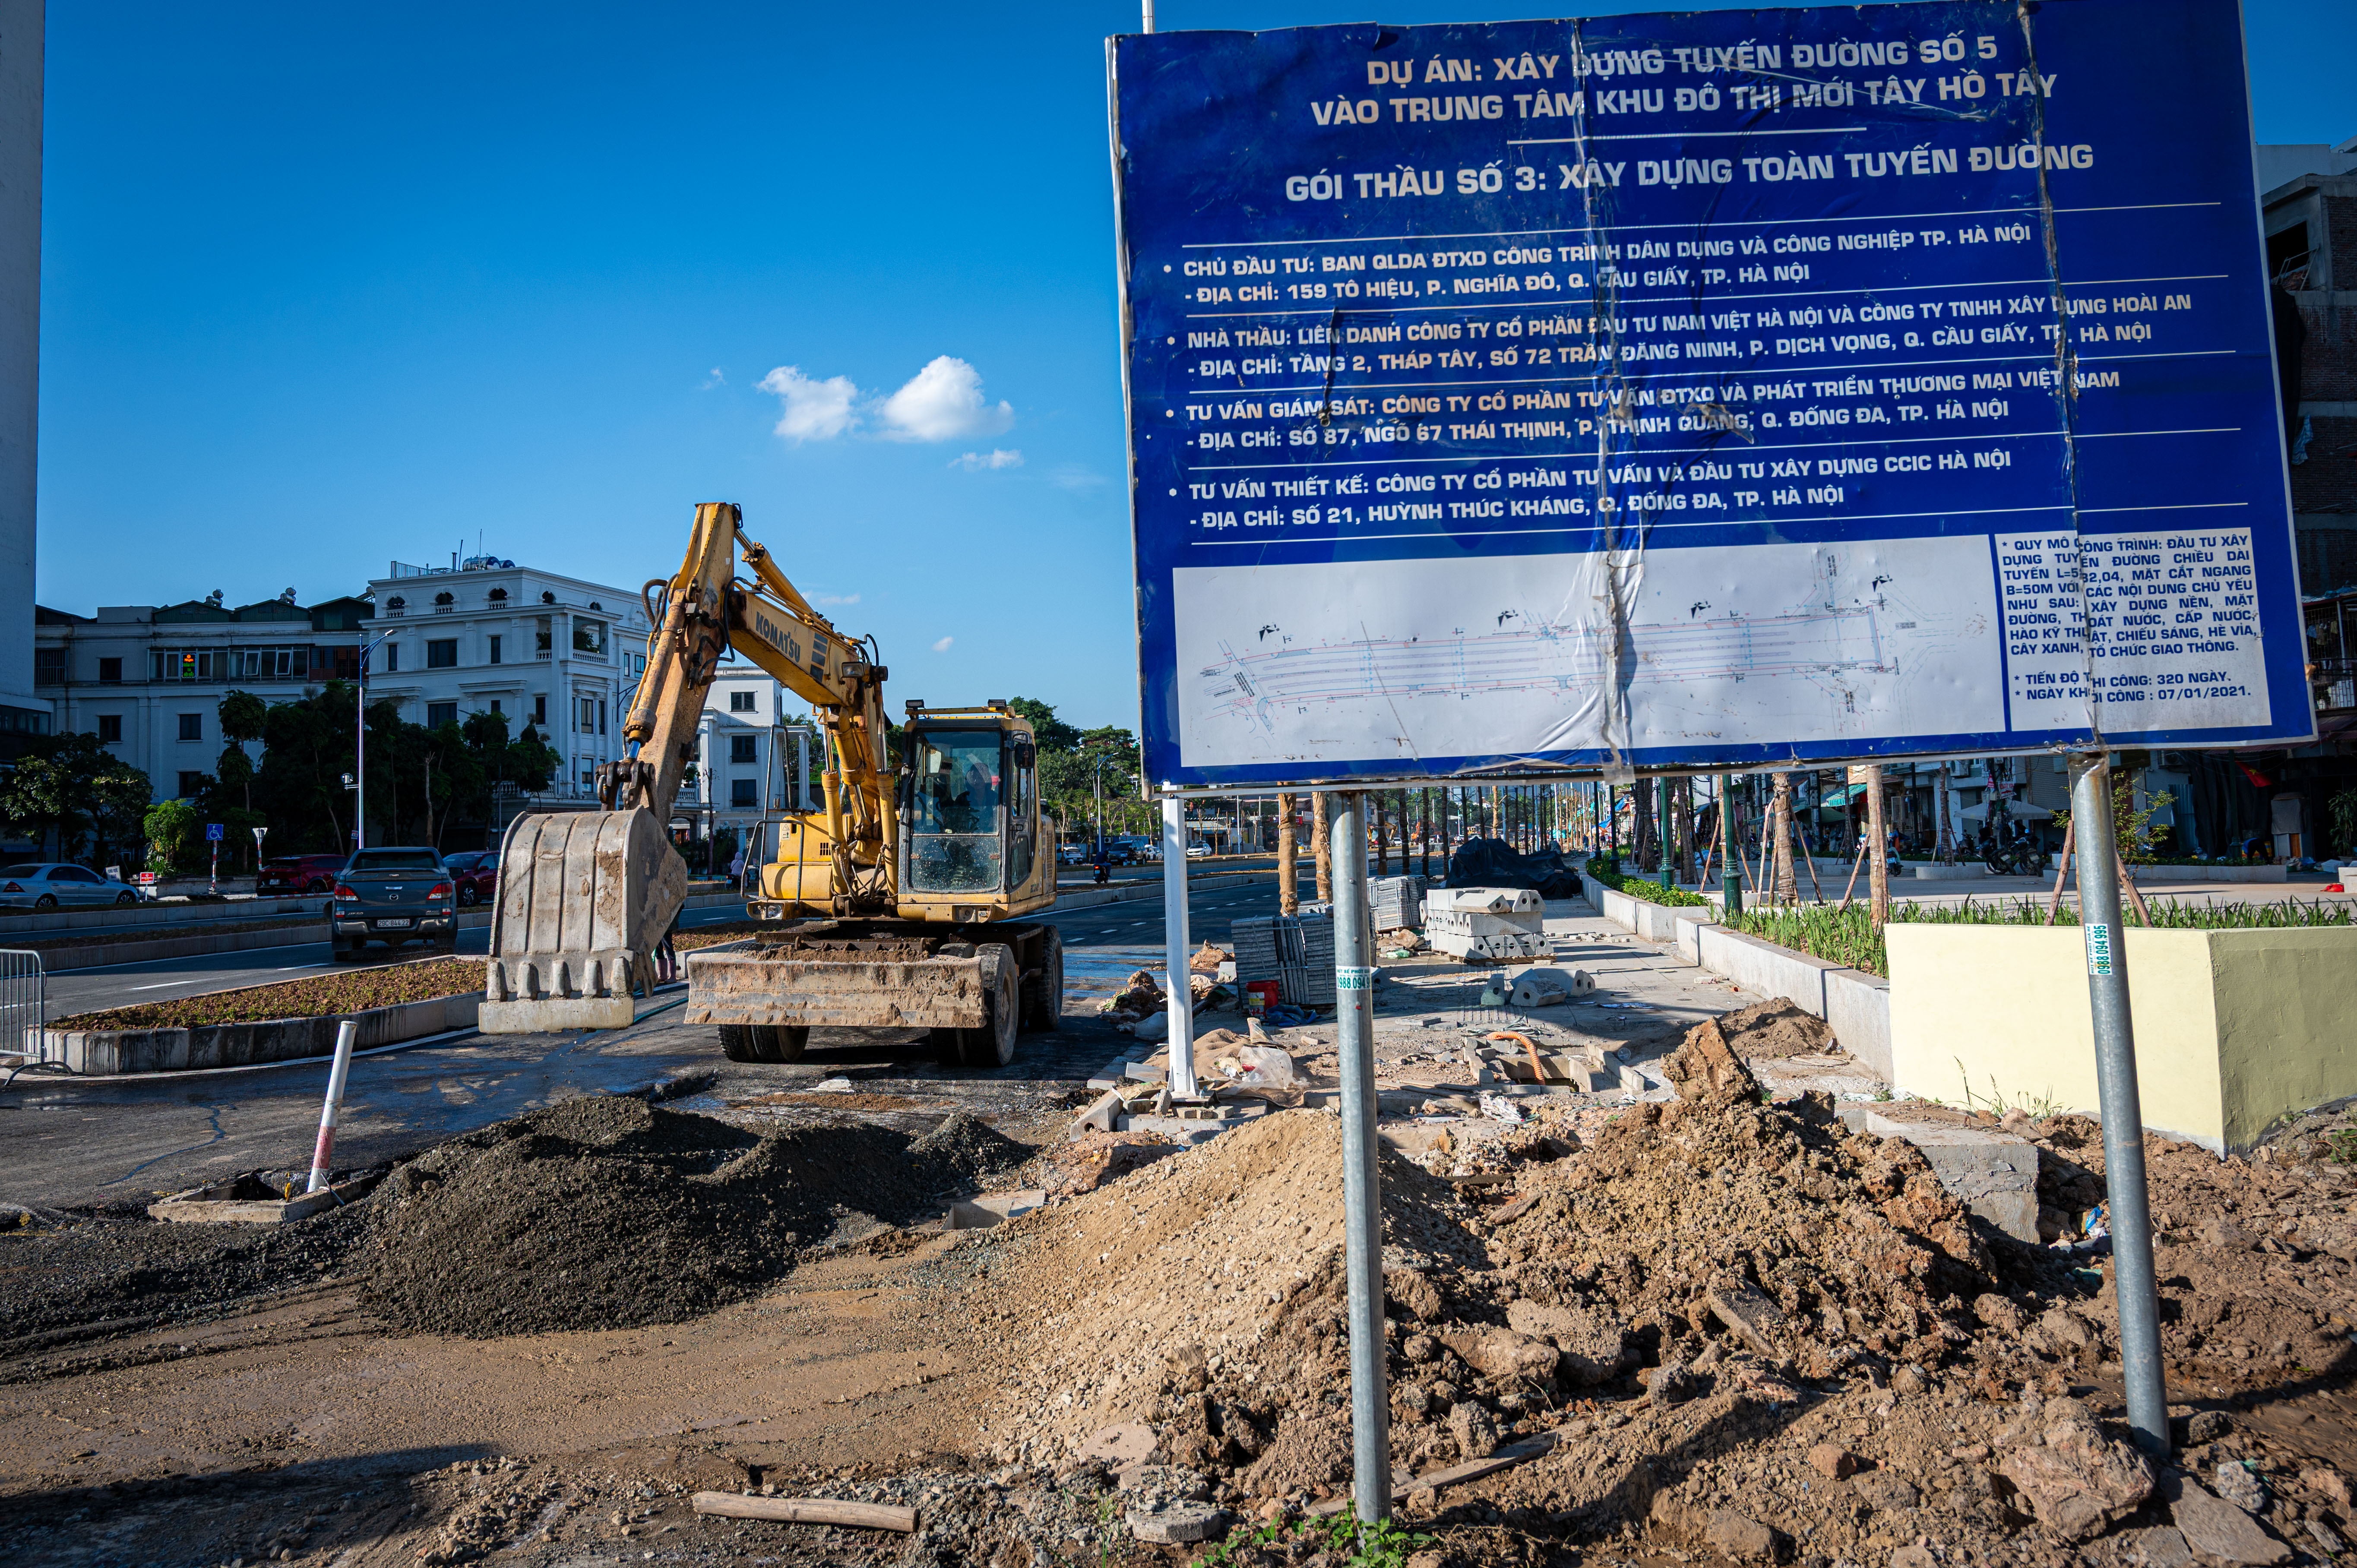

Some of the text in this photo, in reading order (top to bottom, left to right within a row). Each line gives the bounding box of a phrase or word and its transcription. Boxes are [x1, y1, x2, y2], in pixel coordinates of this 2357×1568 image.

[1368, 30, 1997, 89] DỰ ÁN: XÂY DỰNG TUYẾN ĐƯỜNG SỐ 5
[1311, 69, 2056, 125] VÀO TRUNG TÂM KHU ĐÔ THỊ MỚI TÂY HỒ TÂY
[1286, 139, 2093, 201] GÓI THẦU SỐ 3: XÂY DỰNG TOÀN TUYẾN ĐƯỜNG
[1184, 223, 2031, 276] CHỦ ĐẦU TƯ: BAN QLDA ĐTXD CÔNG TRÌNH DÂN DỤNG VÀ CÔNG NGHIỆP TP. HÀ NỘI
[1189, 448, 2011, 499] TƯ VẤN THIẾT KẾ: CÔNG TY CỔ PHẦN TƯ VẤN VÀ ĐẦU TƯ XÂY DỰNG CCIC HÀ NỘI
[1202, 512, 1237, 530] ĐỊA
[1244, 506, 1284, 526] CHỈ:
[1292, 504, 1320, 524] SỐ
[1328, 507, 1360, 525] 21,
[1369, 501, 1443, 521] HUỲNH
[1449, 499, 1503, 518] THÚC
[1512, 496, 1590, 516] KHÁNG,
[1628, 490, 1686, 511] ĐỐNG
[1692, 493, 1727, 510] ĐA,
[1734, 491, 1765, 507] TP.
[1772, 486, 1801, 506] HÀ
[1808, 484, 1844, 506] NỘI
[2015, 533, 2248, 553] QUY MÔ CÔNG TRÌNH: ĐẦU TƯ XÂY
[2003, 549, 2249, 569] DỰNG TUYẾN ĐƯỜNG CHIỀU DÀI
[2004, 566, 2049, 580] TUYẾN
[2132, 568, 2161, 582] MẶT
[2168, 564, 2194, 579] CẮT
[2202, 566, 2251, 577] NGANG
[2006, 576, 2253, 597] B=50M VỚI CÁC NỘI DUNG CHỦ YẾU
[2008, 594, 2254, 613] NHƯ SAU: XÂY DỰNG NỀN, MẶT
[2009, 611, 2061, 626] ĐƯỜNG,
[2071, 610, 2113, 628] THOÁT
[2123, 612, 2165, 627] NƯỚC,
[2176, 608, 2202, 624] CẤP
[756, 611, 800, 663] KOMATSU
[2010, 627, 2038, 640] HÀO
[2043, 626, 2061, 639] KỸ
[2117, 625, 2157, 642] CHIẾU
[2161, 624, 2203, 640] SÁNG,
[2208, 624, 2227, 637] HÈ
[2231, 622, 2257, 637] VỈA,
[2011, 639, 2239, 658] CÂY XANH, TỔ CHỨC GIAO THÔNG.
[2025, 670, 2232, 688] TIẾN ĐỘ THI CÔNG: 320 NGÀY.
[2027, 686, 2064, 700] NGÀY
[2107, 689, 2145, 702] CÔNG
[2158, 686, 2251, 700] 07/01/2021.
[2094, 926, 2110, 974] 0988.094.995
